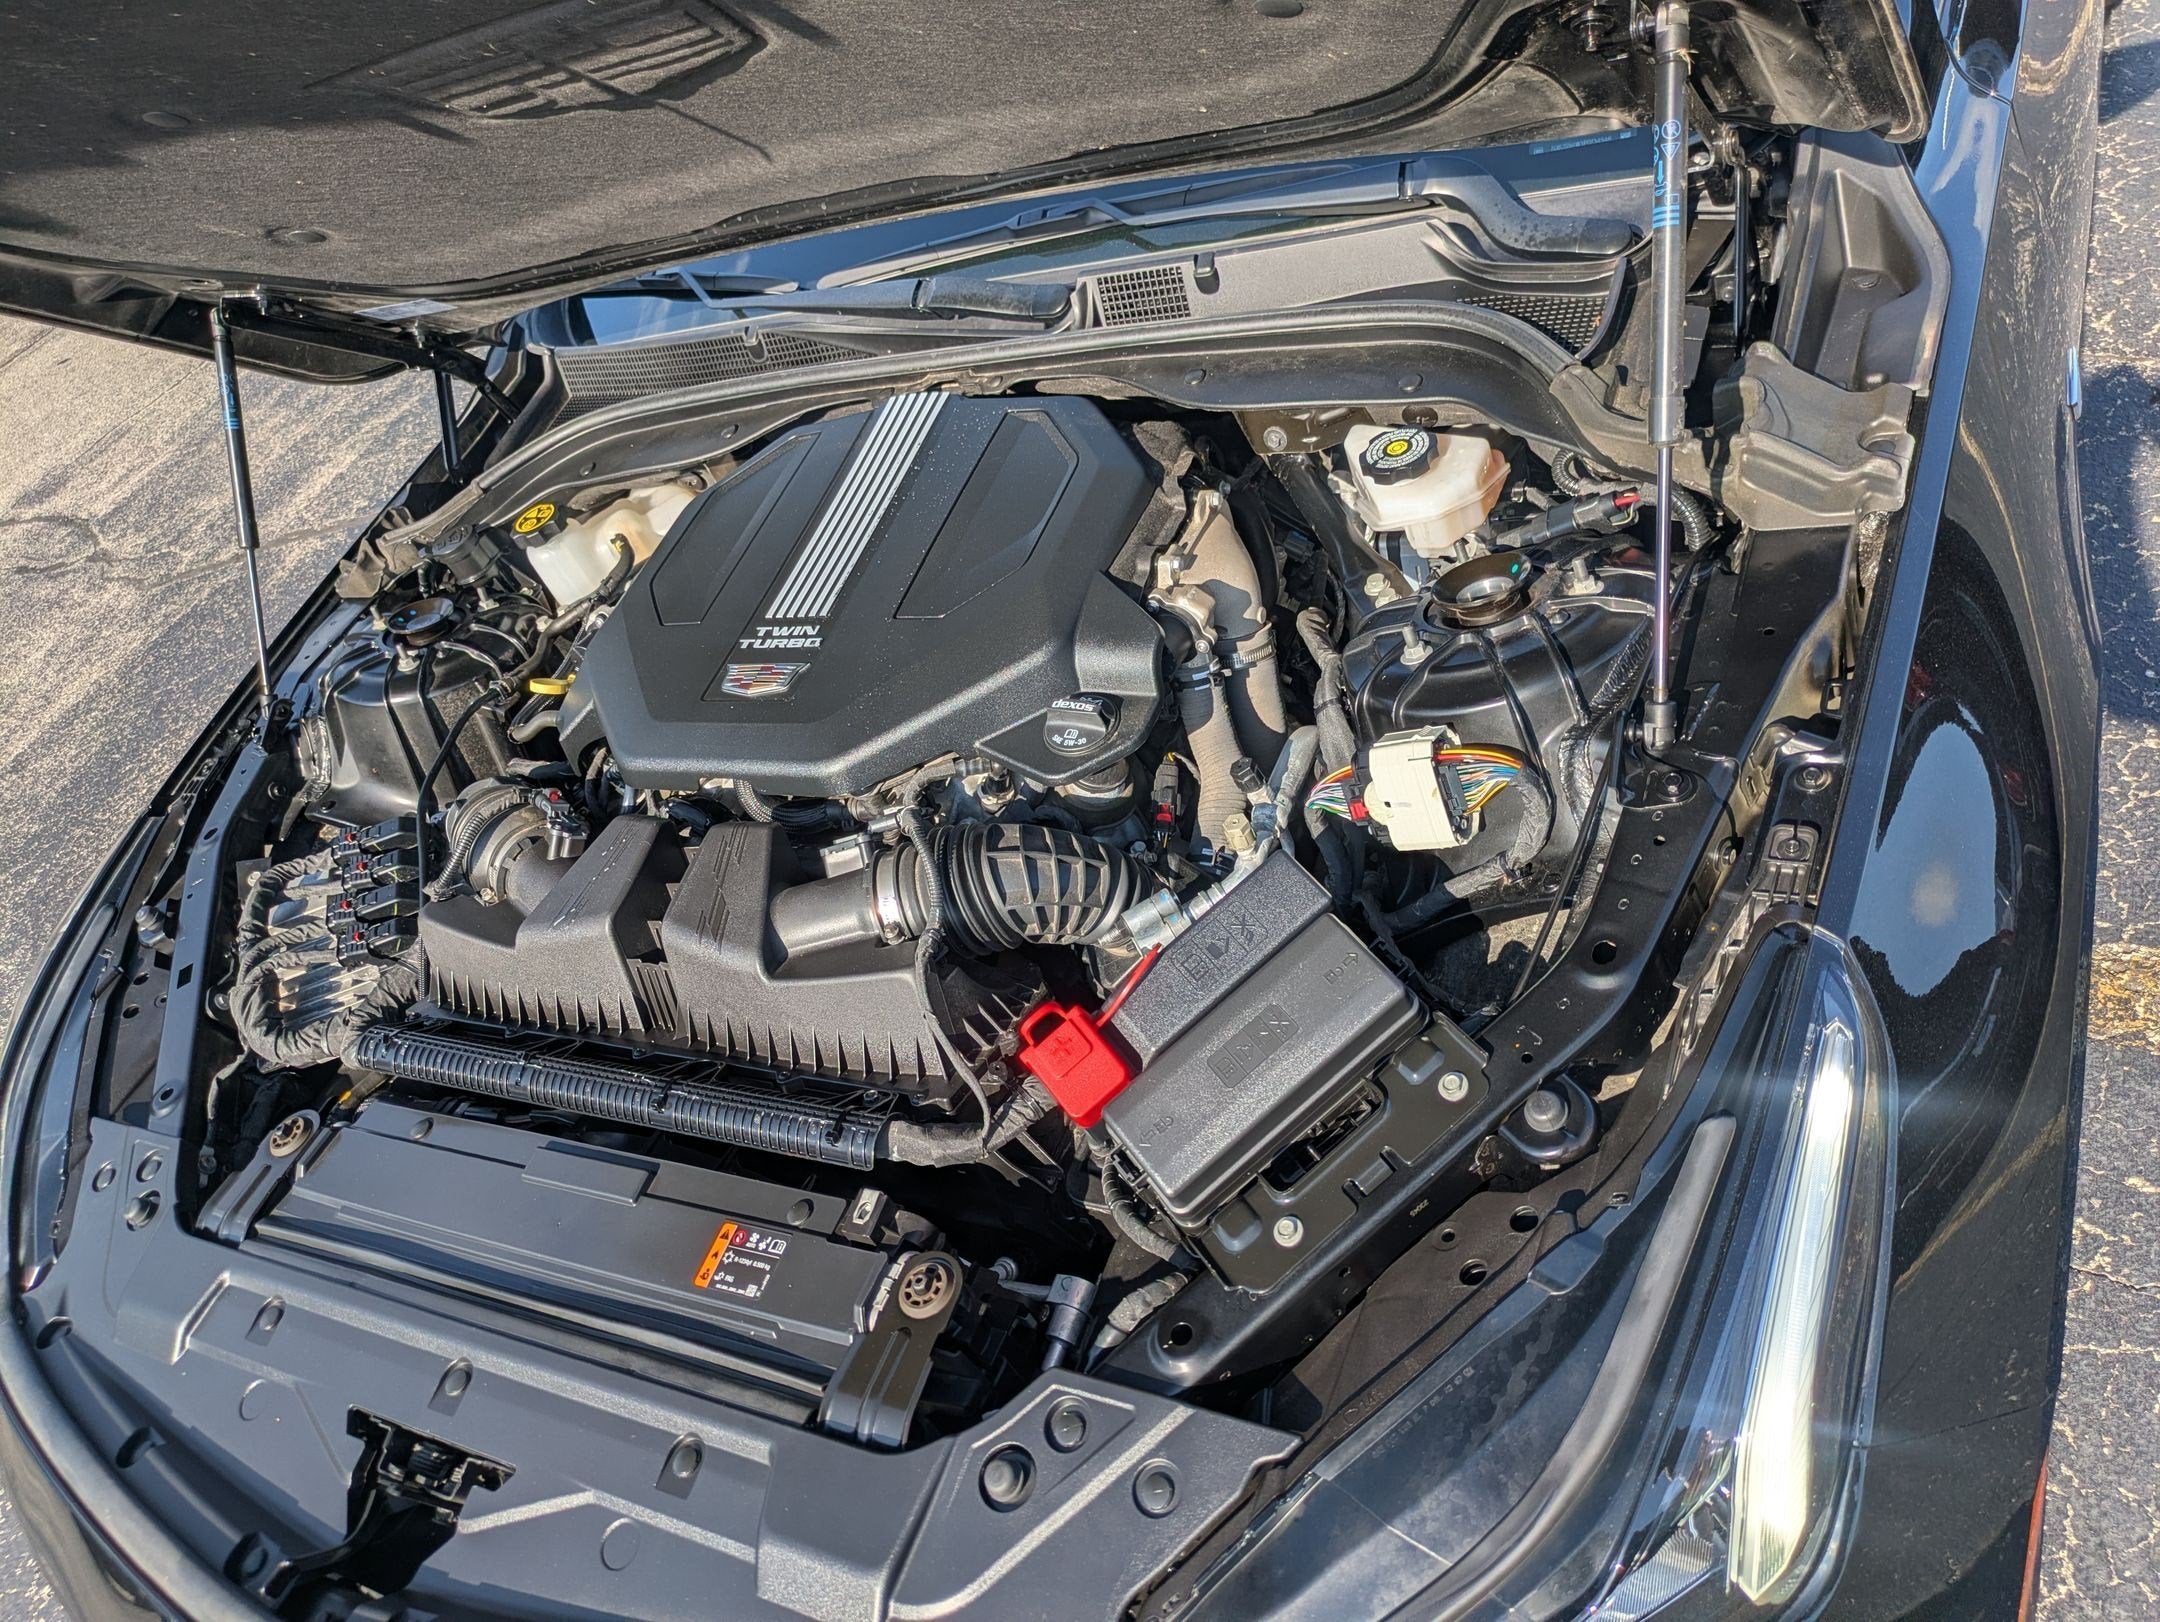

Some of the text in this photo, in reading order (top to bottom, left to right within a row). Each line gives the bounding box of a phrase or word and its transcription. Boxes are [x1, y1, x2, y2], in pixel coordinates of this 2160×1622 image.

[756, 625, 821, 636] TWIN
[739, 638, 823, 648] TURBO
[1052, 699, 1095, 711] dexos
[1064, 738, 1087, 746] 5W-30
